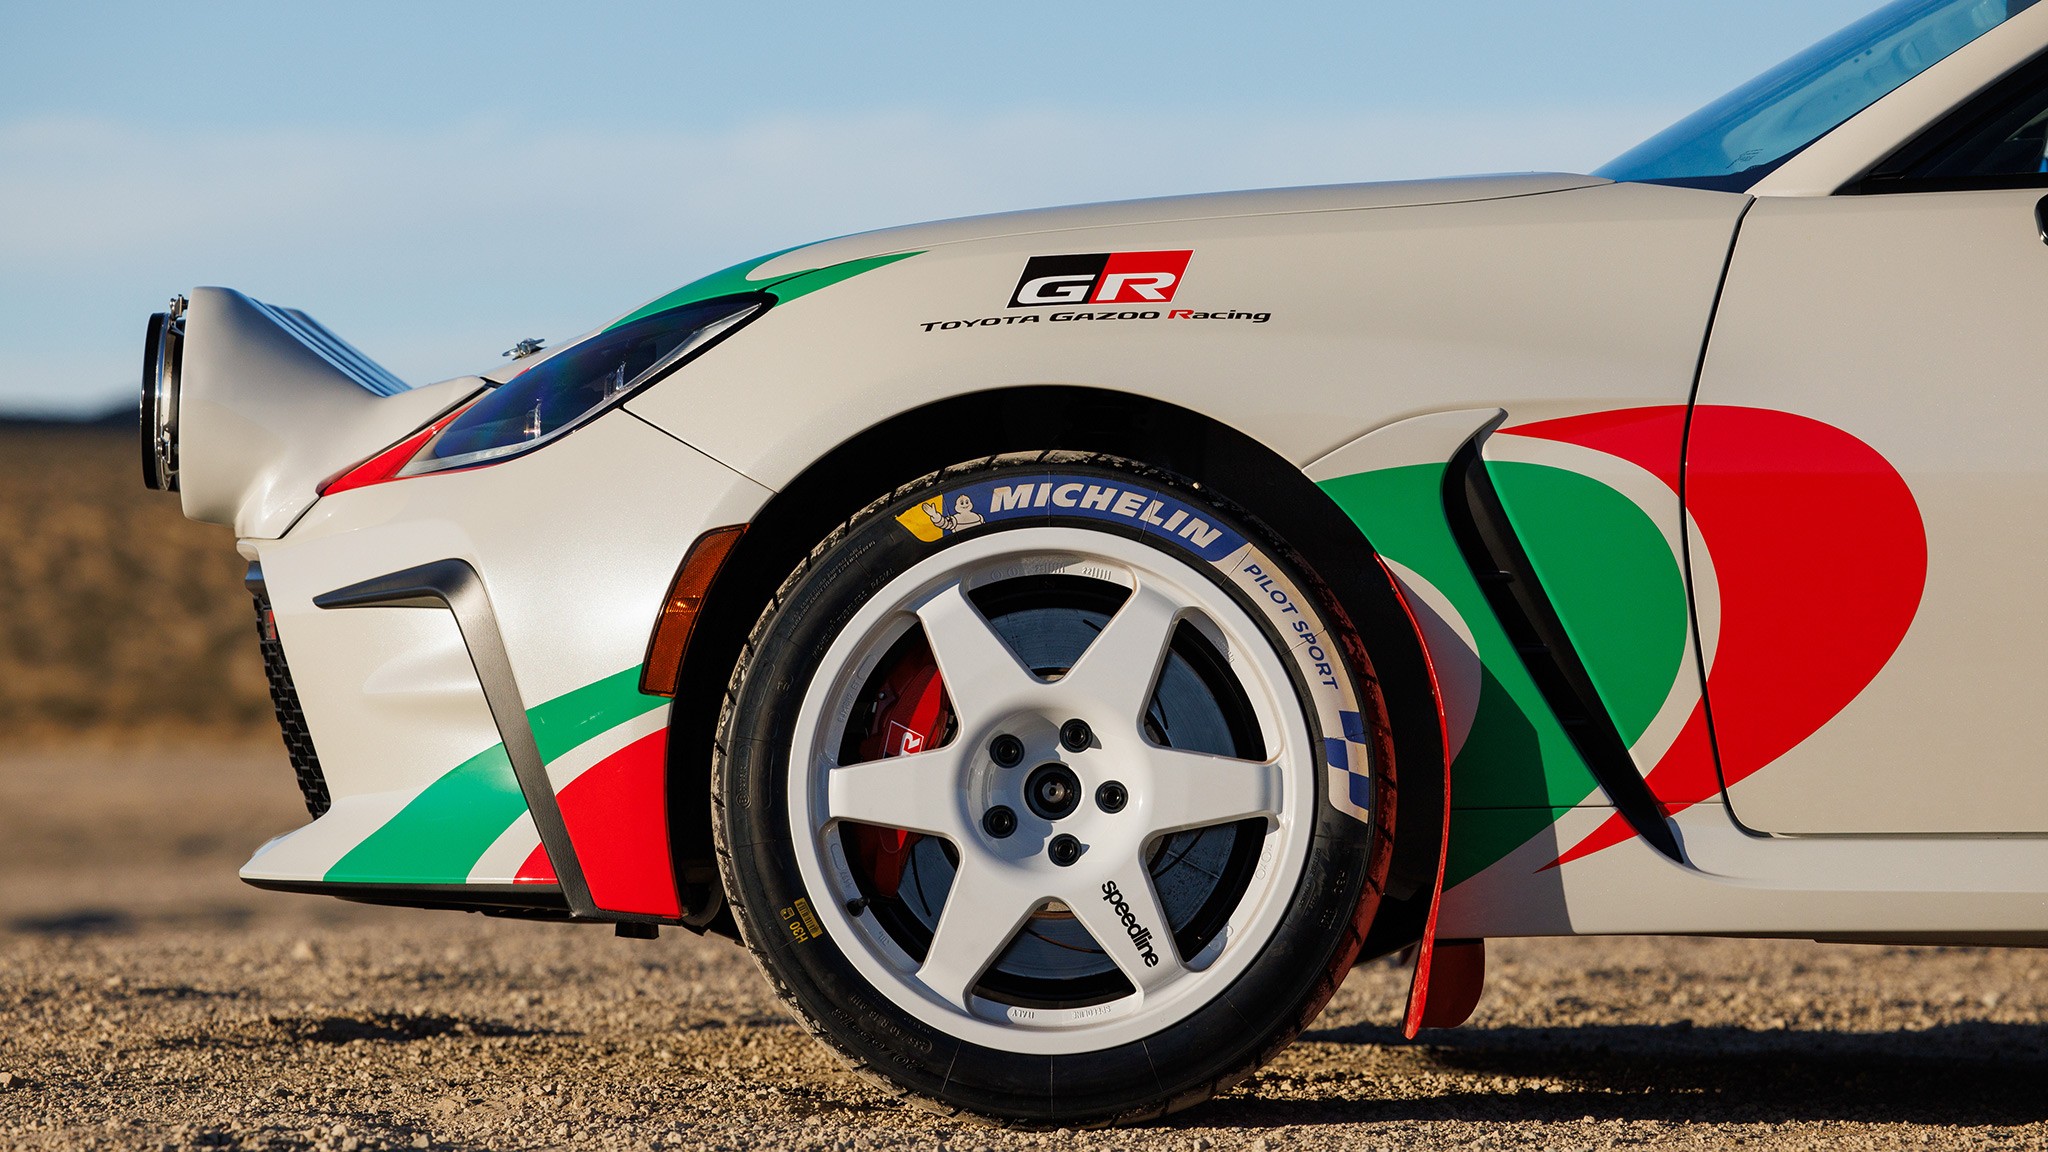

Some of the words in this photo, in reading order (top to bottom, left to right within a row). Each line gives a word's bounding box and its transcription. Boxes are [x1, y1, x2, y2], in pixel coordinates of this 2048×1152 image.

[1017, 272, 1176, 304] GR
[920, 315, 1040, 332] TOYOTA
[1049, 311, 1160, 322] GAZOO
[1168, 309, 1272, 323] Racing
[990, 483, 1223, 549] MICHELIN
[1243, 564, 1298, 614] PILOT
[1292, 621, 1338, 689] SPORT
[788, 921, 809, 944] H30
[1102, 881, 1159, 967] speedline
